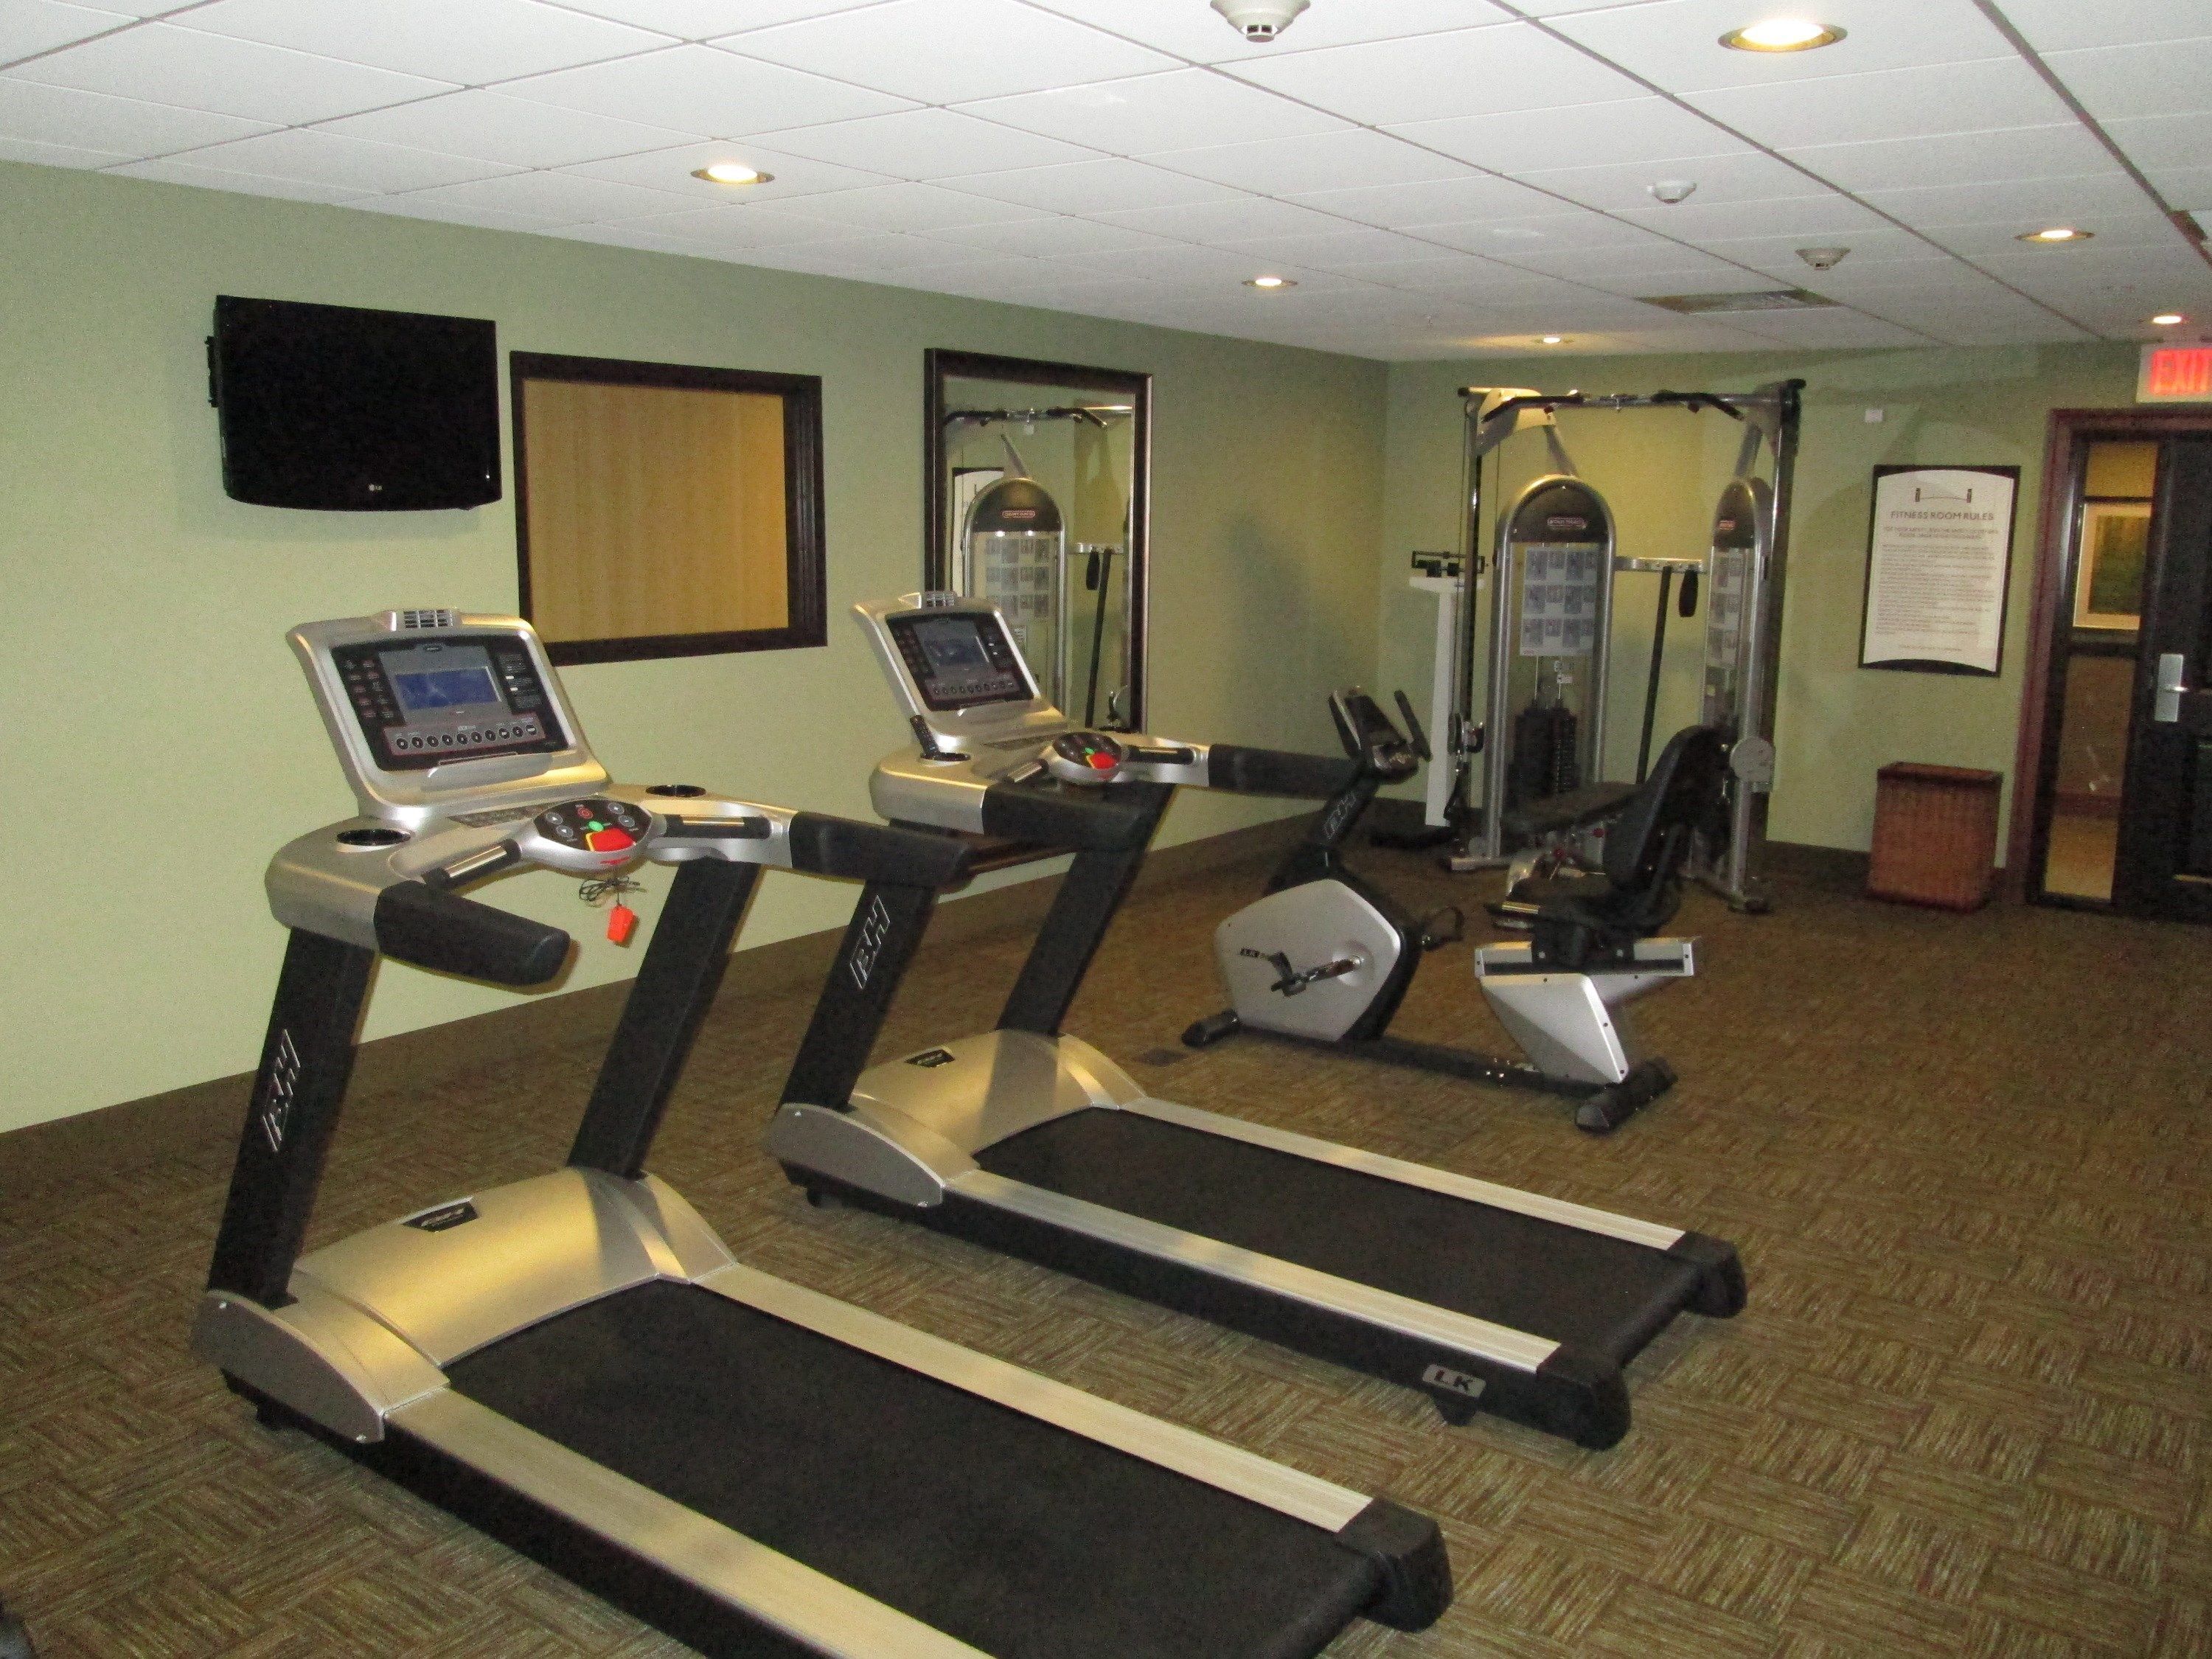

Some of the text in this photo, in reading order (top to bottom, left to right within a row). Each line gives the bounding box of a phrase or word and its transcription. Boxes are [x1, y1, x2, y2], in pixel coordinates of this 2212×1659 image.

[2152, 349, 2212, 393] EXI
[1891, 511, 1994, 521] FITNESS ROOM RULES
[1433, 1369, 1474, 1391] LK
